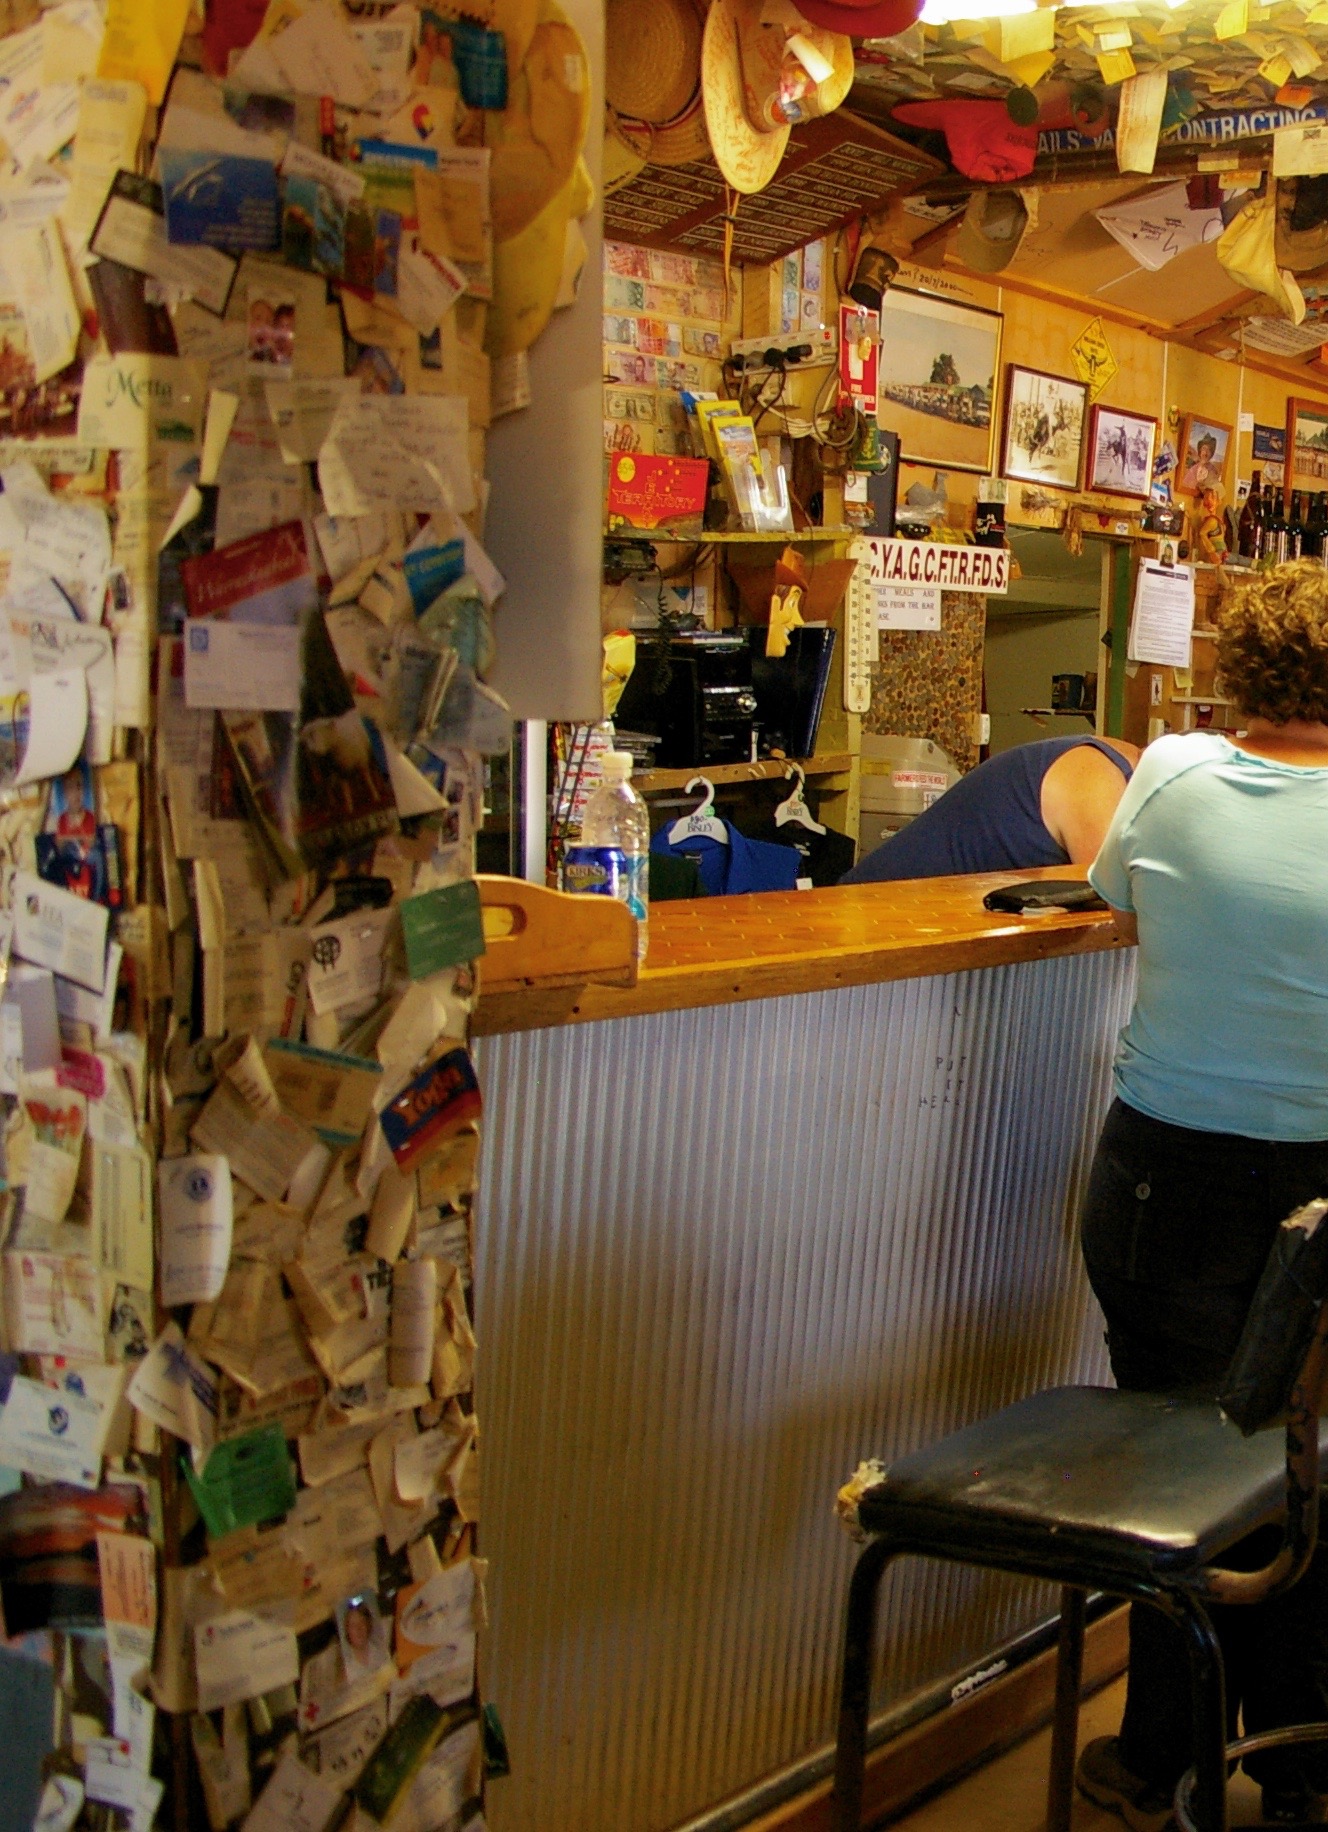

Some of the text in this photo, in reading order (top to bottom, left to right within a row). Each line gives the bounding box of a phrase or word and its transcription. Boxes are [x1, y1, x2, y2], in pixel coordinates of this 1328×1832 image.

[612, 488, 696, 510] TERRITORY
[923, 590, 935, 598] AND
[908, 602, 919, 610] THE
